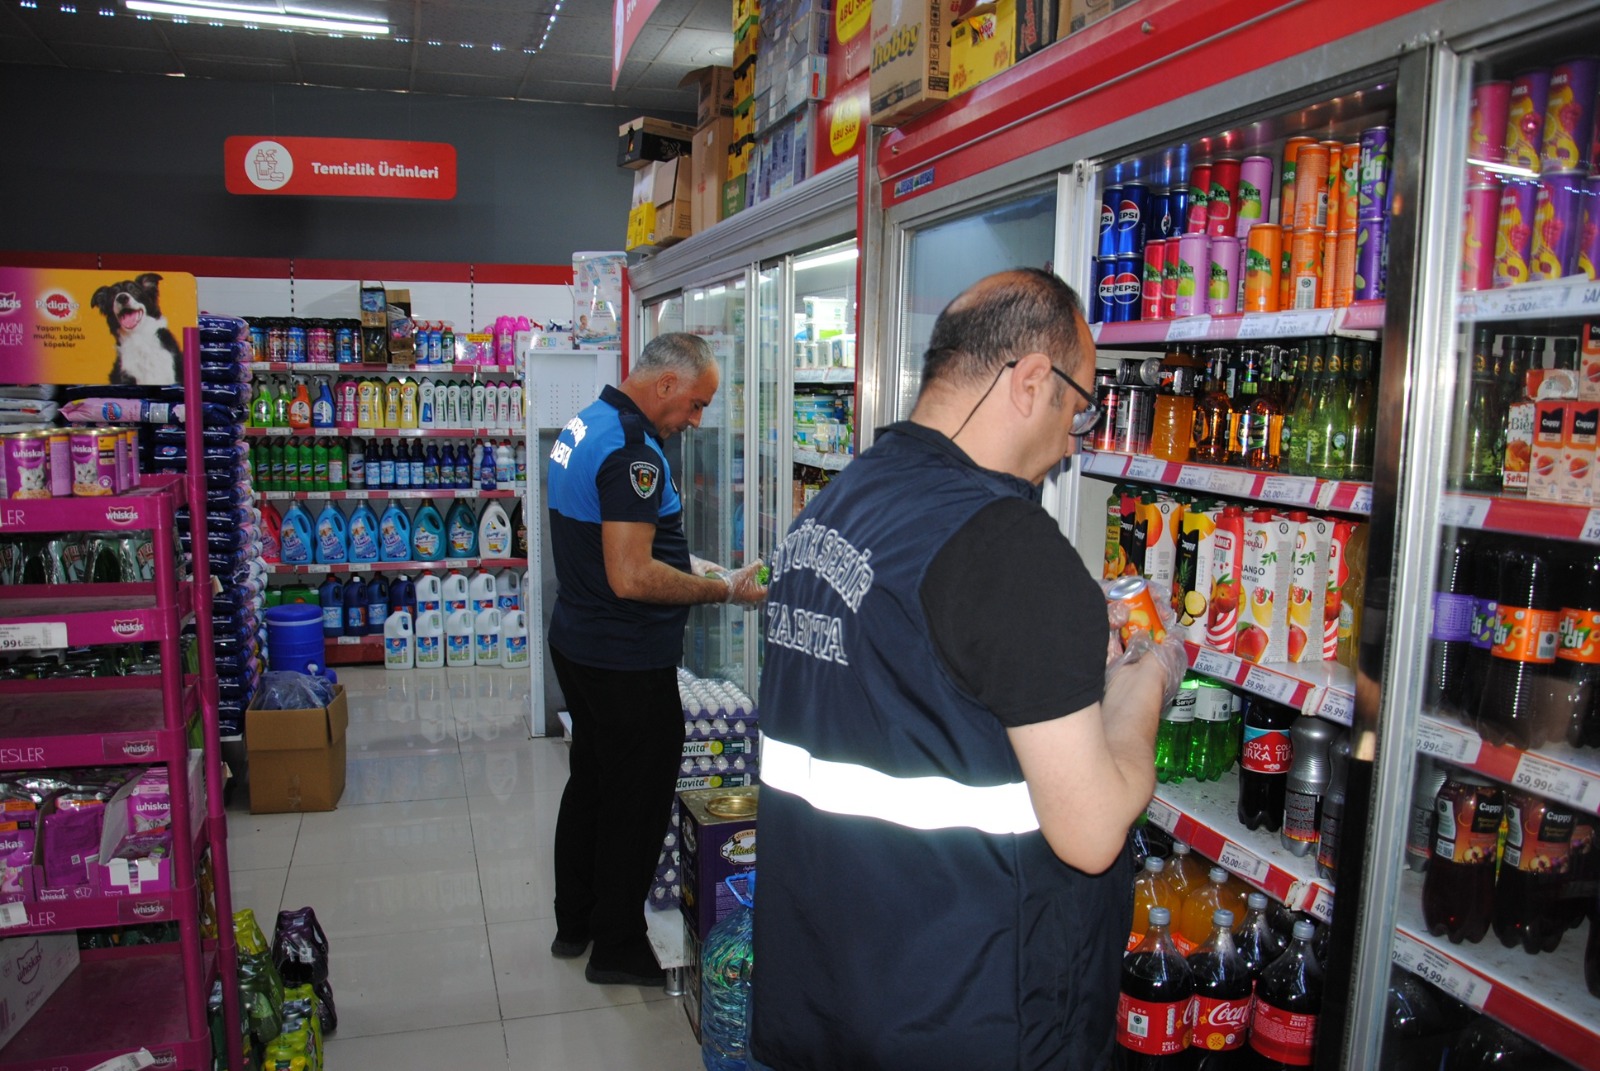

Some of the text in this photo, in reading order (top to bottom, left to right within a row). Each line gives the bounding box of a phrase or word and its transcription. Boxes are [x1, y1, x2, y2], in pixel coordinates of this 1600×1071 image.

[871, 22, 921, 74] hobby
[311, 160, 440, 180] Temizlik Ürünleri
[1119, 211, 1138, 220] EPSI
[1114, 284, 1140, 293] PEPSI
[36, 300, 80, 311] Pedigree
[36, 325, 82, 334] Yaşam boyu
[59, 334, 85, 342] sağlıklı
[13, 449, 46, 458] whiskas
[1506, 474, 1526, 483] Şefta
[105, 510, 139, 521] whiskas
[111, 622, 145, 634] whiskas
[767, 602, 849, 666] ZABITA
[122, 743, 155, 753] whiskas
[683, 742, 706, 754] ovita
[1248, 741, 1270, 752] COLA
[676, 778, 706, 789] dovita
[1478, 802, 1502, 814] Cappy
[1545, 811, 1572, 824] Cappy
[132, 902, 164, 914] whiskas
